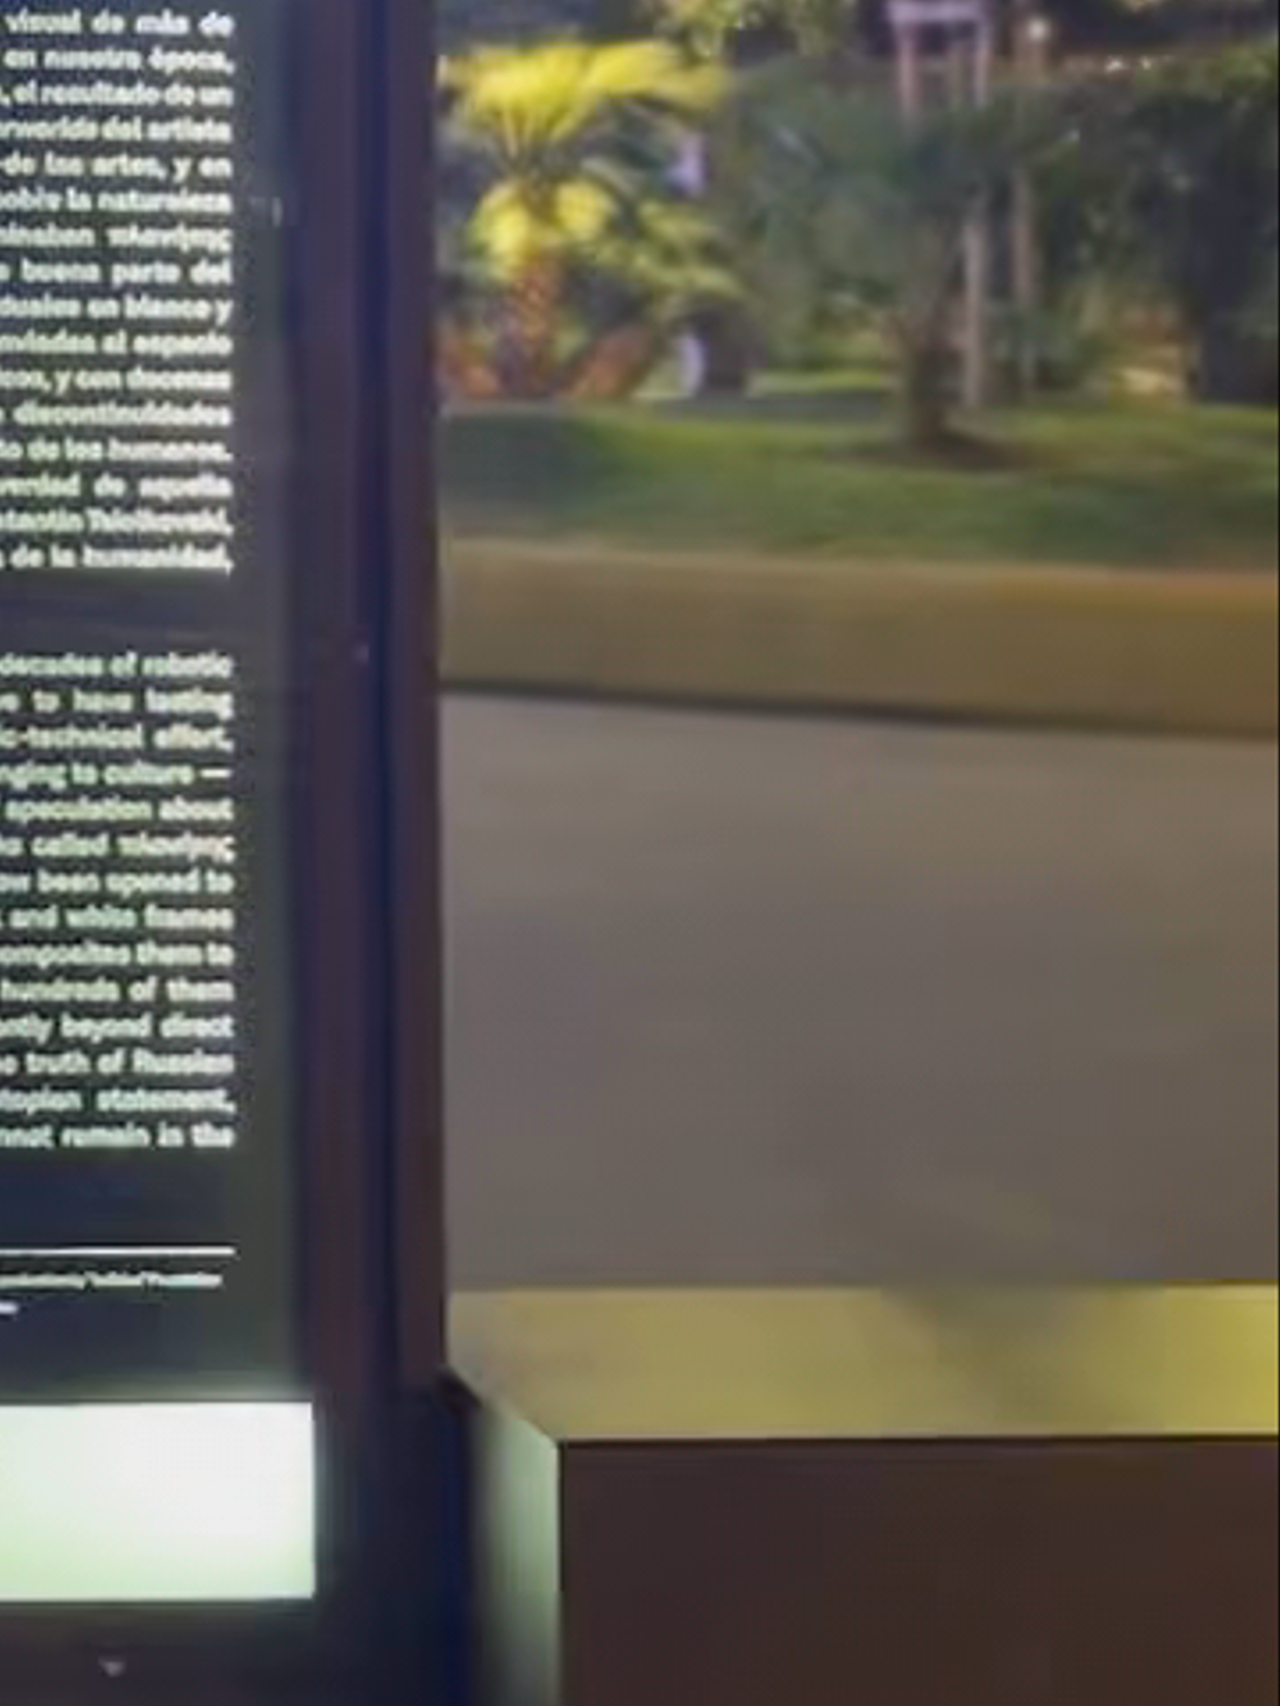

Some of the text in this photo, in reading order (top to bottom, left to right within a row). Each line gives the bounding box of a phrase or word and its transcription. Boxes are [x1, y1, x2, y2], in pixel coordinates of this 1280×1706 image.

[5, 10, 82, 31] visual
[173, 158, 192, 179] y
[32, 691, 60, 712] to
[102, 763, 194, 784] culture
[127, 980, 158, 1001] of
[59, 1016, 152, 1043] beyond
[159, 1016, 234, 1038] direct
[157, 1126, 184, 1148] in
